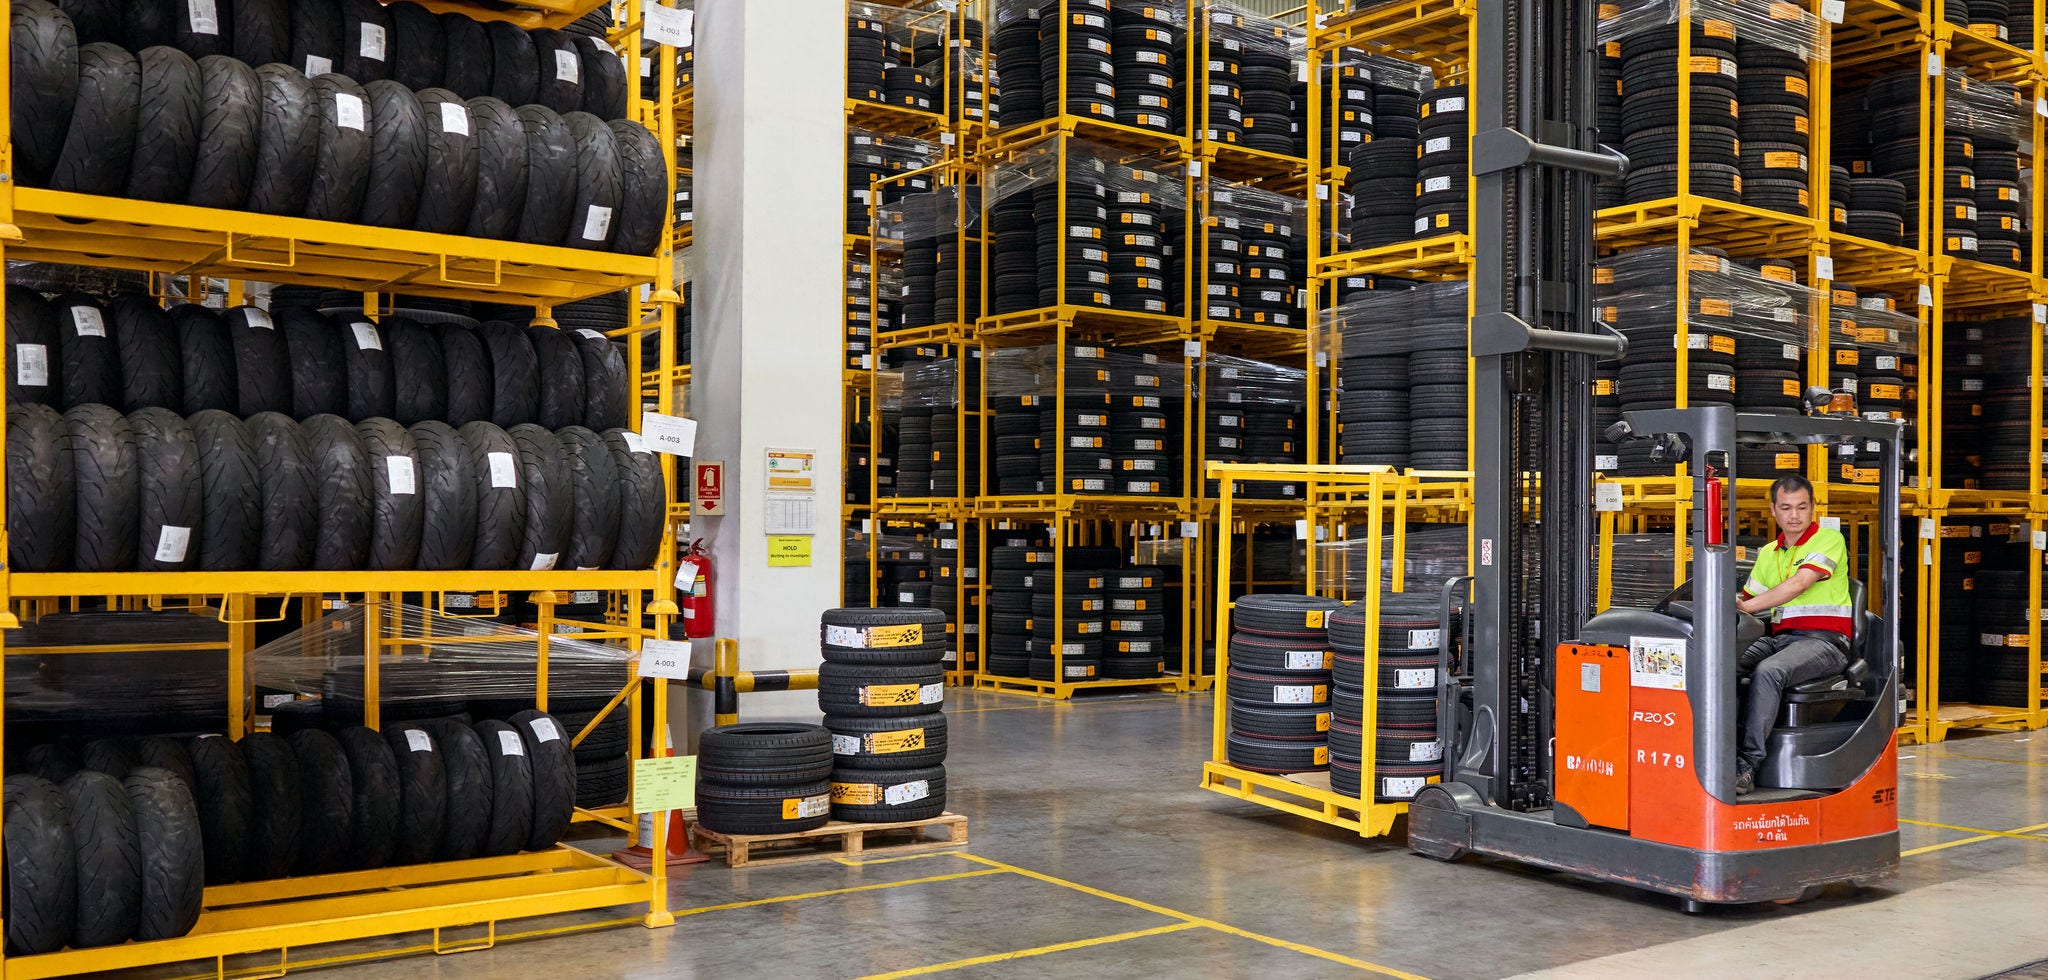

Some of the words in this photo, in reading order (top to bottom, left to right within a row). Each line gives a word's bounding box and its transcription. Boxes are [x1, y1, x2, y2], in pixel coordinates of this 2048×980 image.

[660, 25, 680, 36] A-003
[660, 434, 681, 444] A-003
[654, 659, 676, 668] A-003
